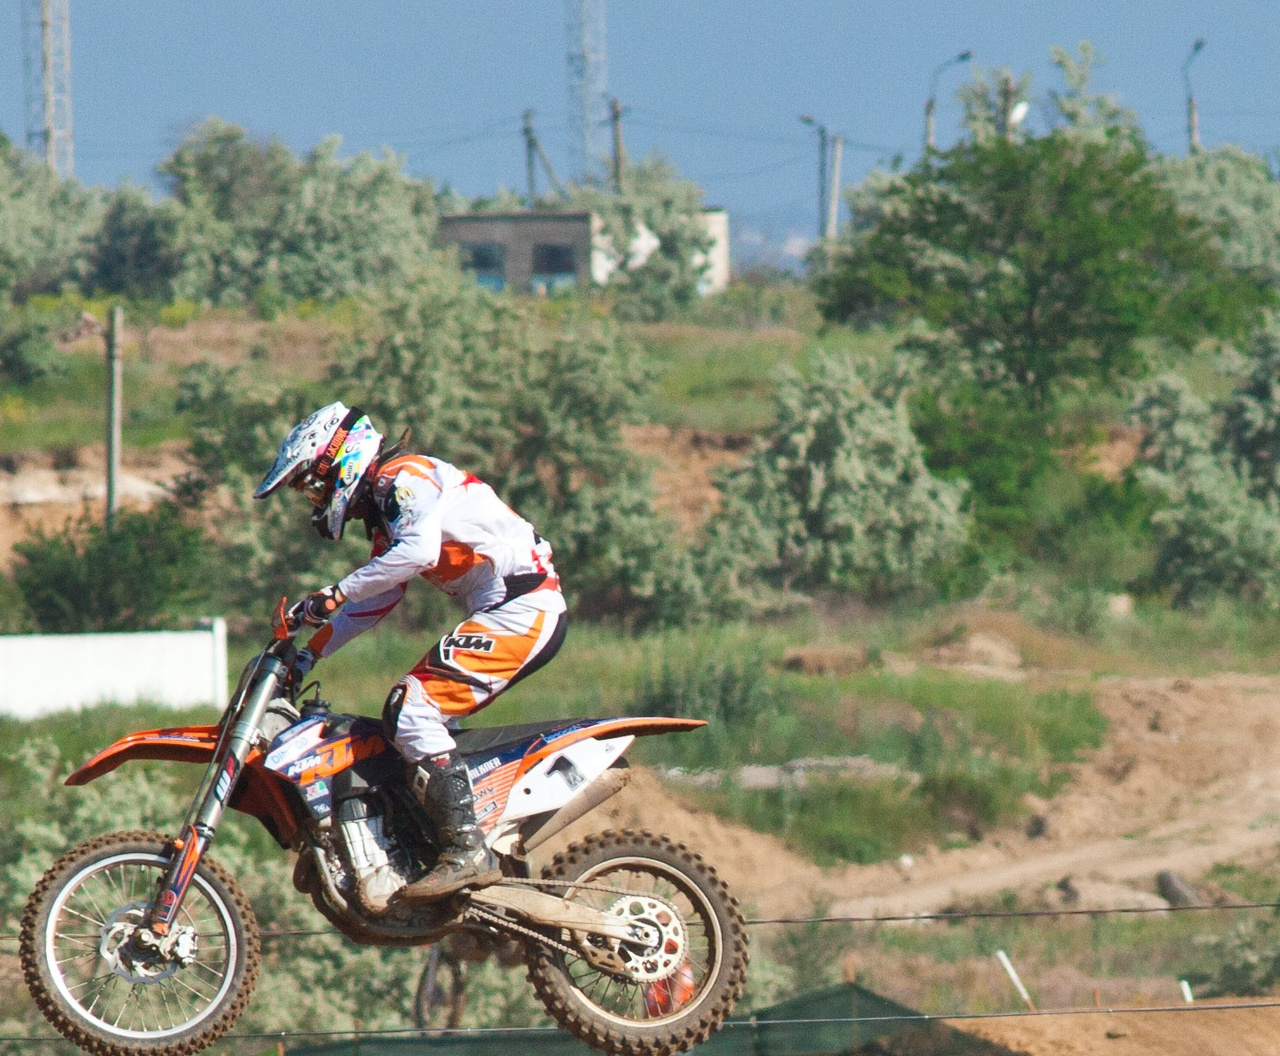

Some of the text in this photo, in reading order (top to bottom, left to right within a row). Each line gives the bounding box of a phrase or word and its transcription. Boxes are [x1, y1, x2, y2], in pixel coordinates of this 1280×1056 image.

[444, 634, 494, 652] KTM
[272, 737, 308, 764] DIMCO
[288, 755, 321, 777] KTM
